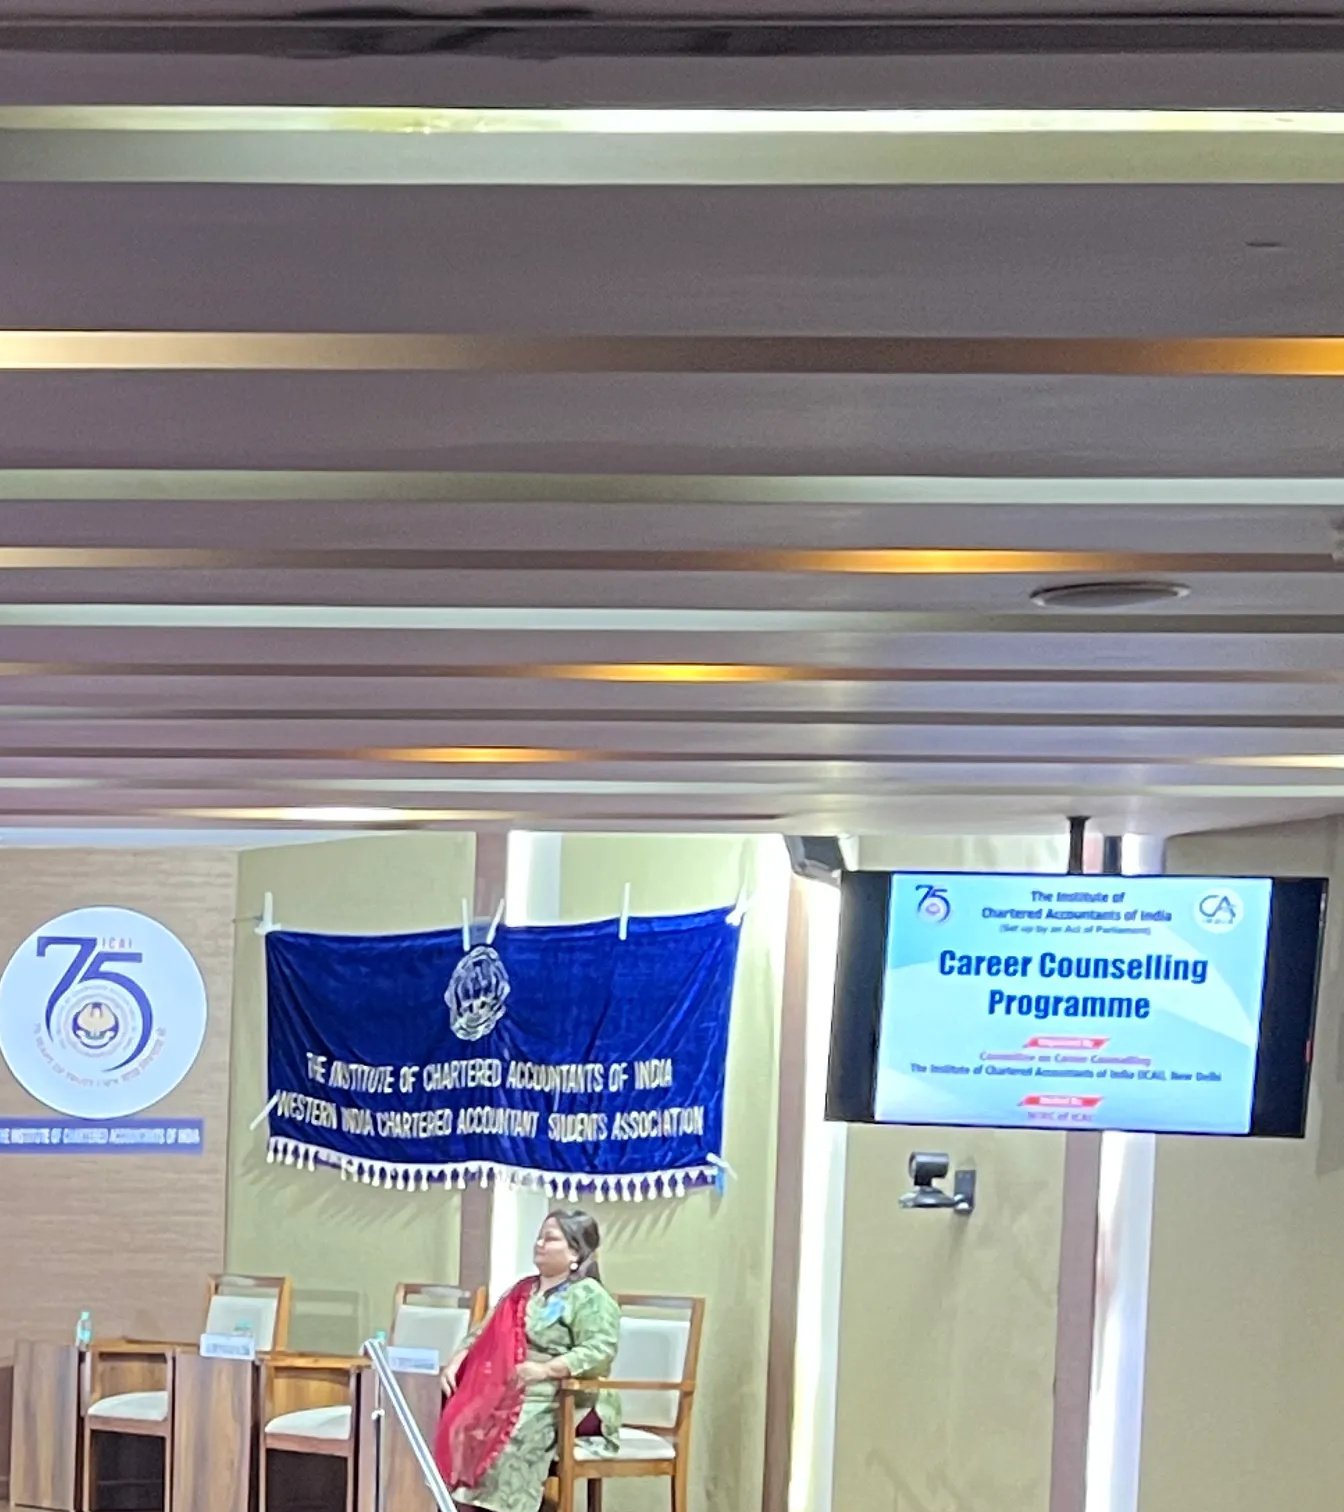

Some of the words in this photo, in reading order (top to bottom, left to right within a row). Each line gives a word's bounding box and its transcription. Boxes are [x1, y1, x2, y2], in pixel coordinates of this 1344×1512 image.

[1032, 891, 1053, 902] The
[1112, 892, 1125, 903] of
[982, 908, 1041, 919] Chartered
[1046, 909, 1120, 920] Accountants
[1124, 910, 1136, 920] of
[1141, 911, 1172, 921] India
[940, 950, 1032, 976] Career
[1040, 953, 1207, 984] Counselling
[36, 936, 153, 1073] 75
[988, 989, 1150, 1018] Programme
[329, 1061, 394, 1093] INSTITUTE
[399, 1065, 419, 1093] OF
[423, 1059, 502, 1093] CHARTERED
[506, 1059, 604, 1093] ACCOUNTANTS
[608, 1062, 628, 1092] OF
[634, 1058, 673, 1090] INDIA
[277, 1089, 337, 1130] WESTERN
[341, 1106, 375, 1136] INDIA
[376, 1108, 452, 1138] CHARTERED
[611, 1106, 704, 1140] ASSOCIATION
